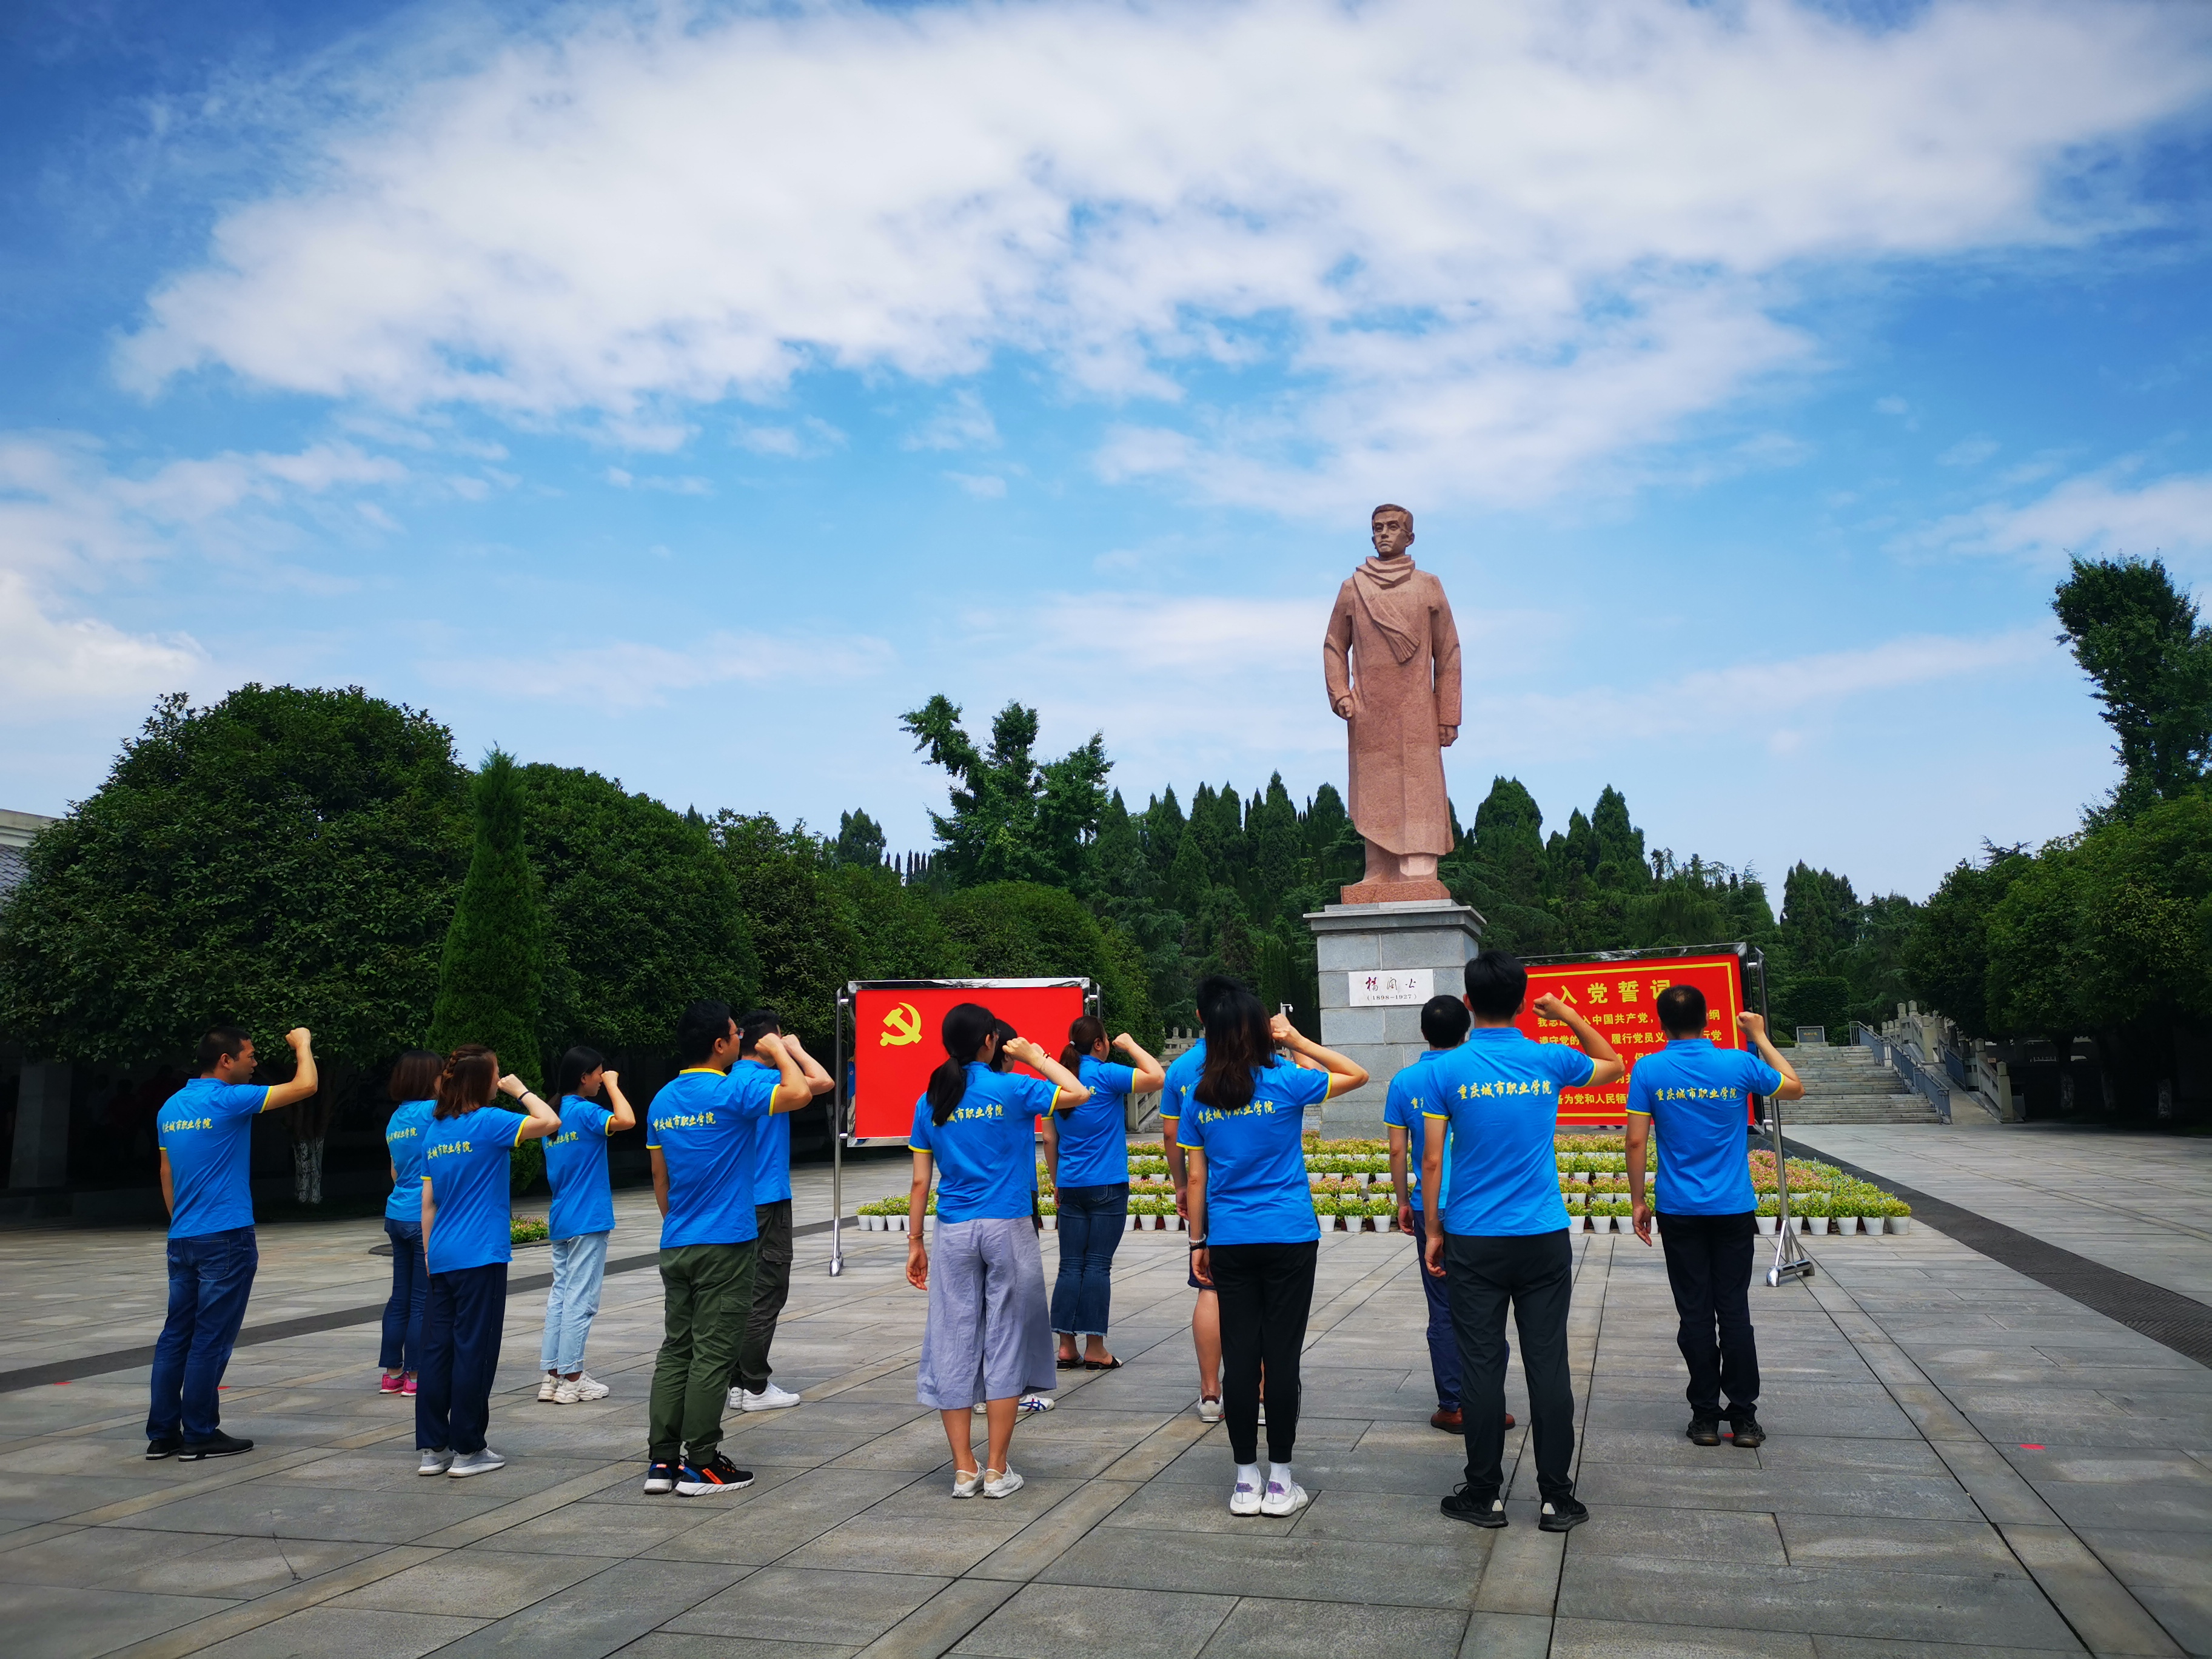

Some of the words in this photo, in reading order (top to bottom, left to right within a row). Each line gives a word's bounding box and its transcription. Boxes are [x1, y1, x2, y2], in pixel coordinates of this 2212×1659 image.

[1457, 1079, 1552, 1100] 重庆城市职业学院
[1655, 1086, 1737, 1101] 重庆城市职业学院
